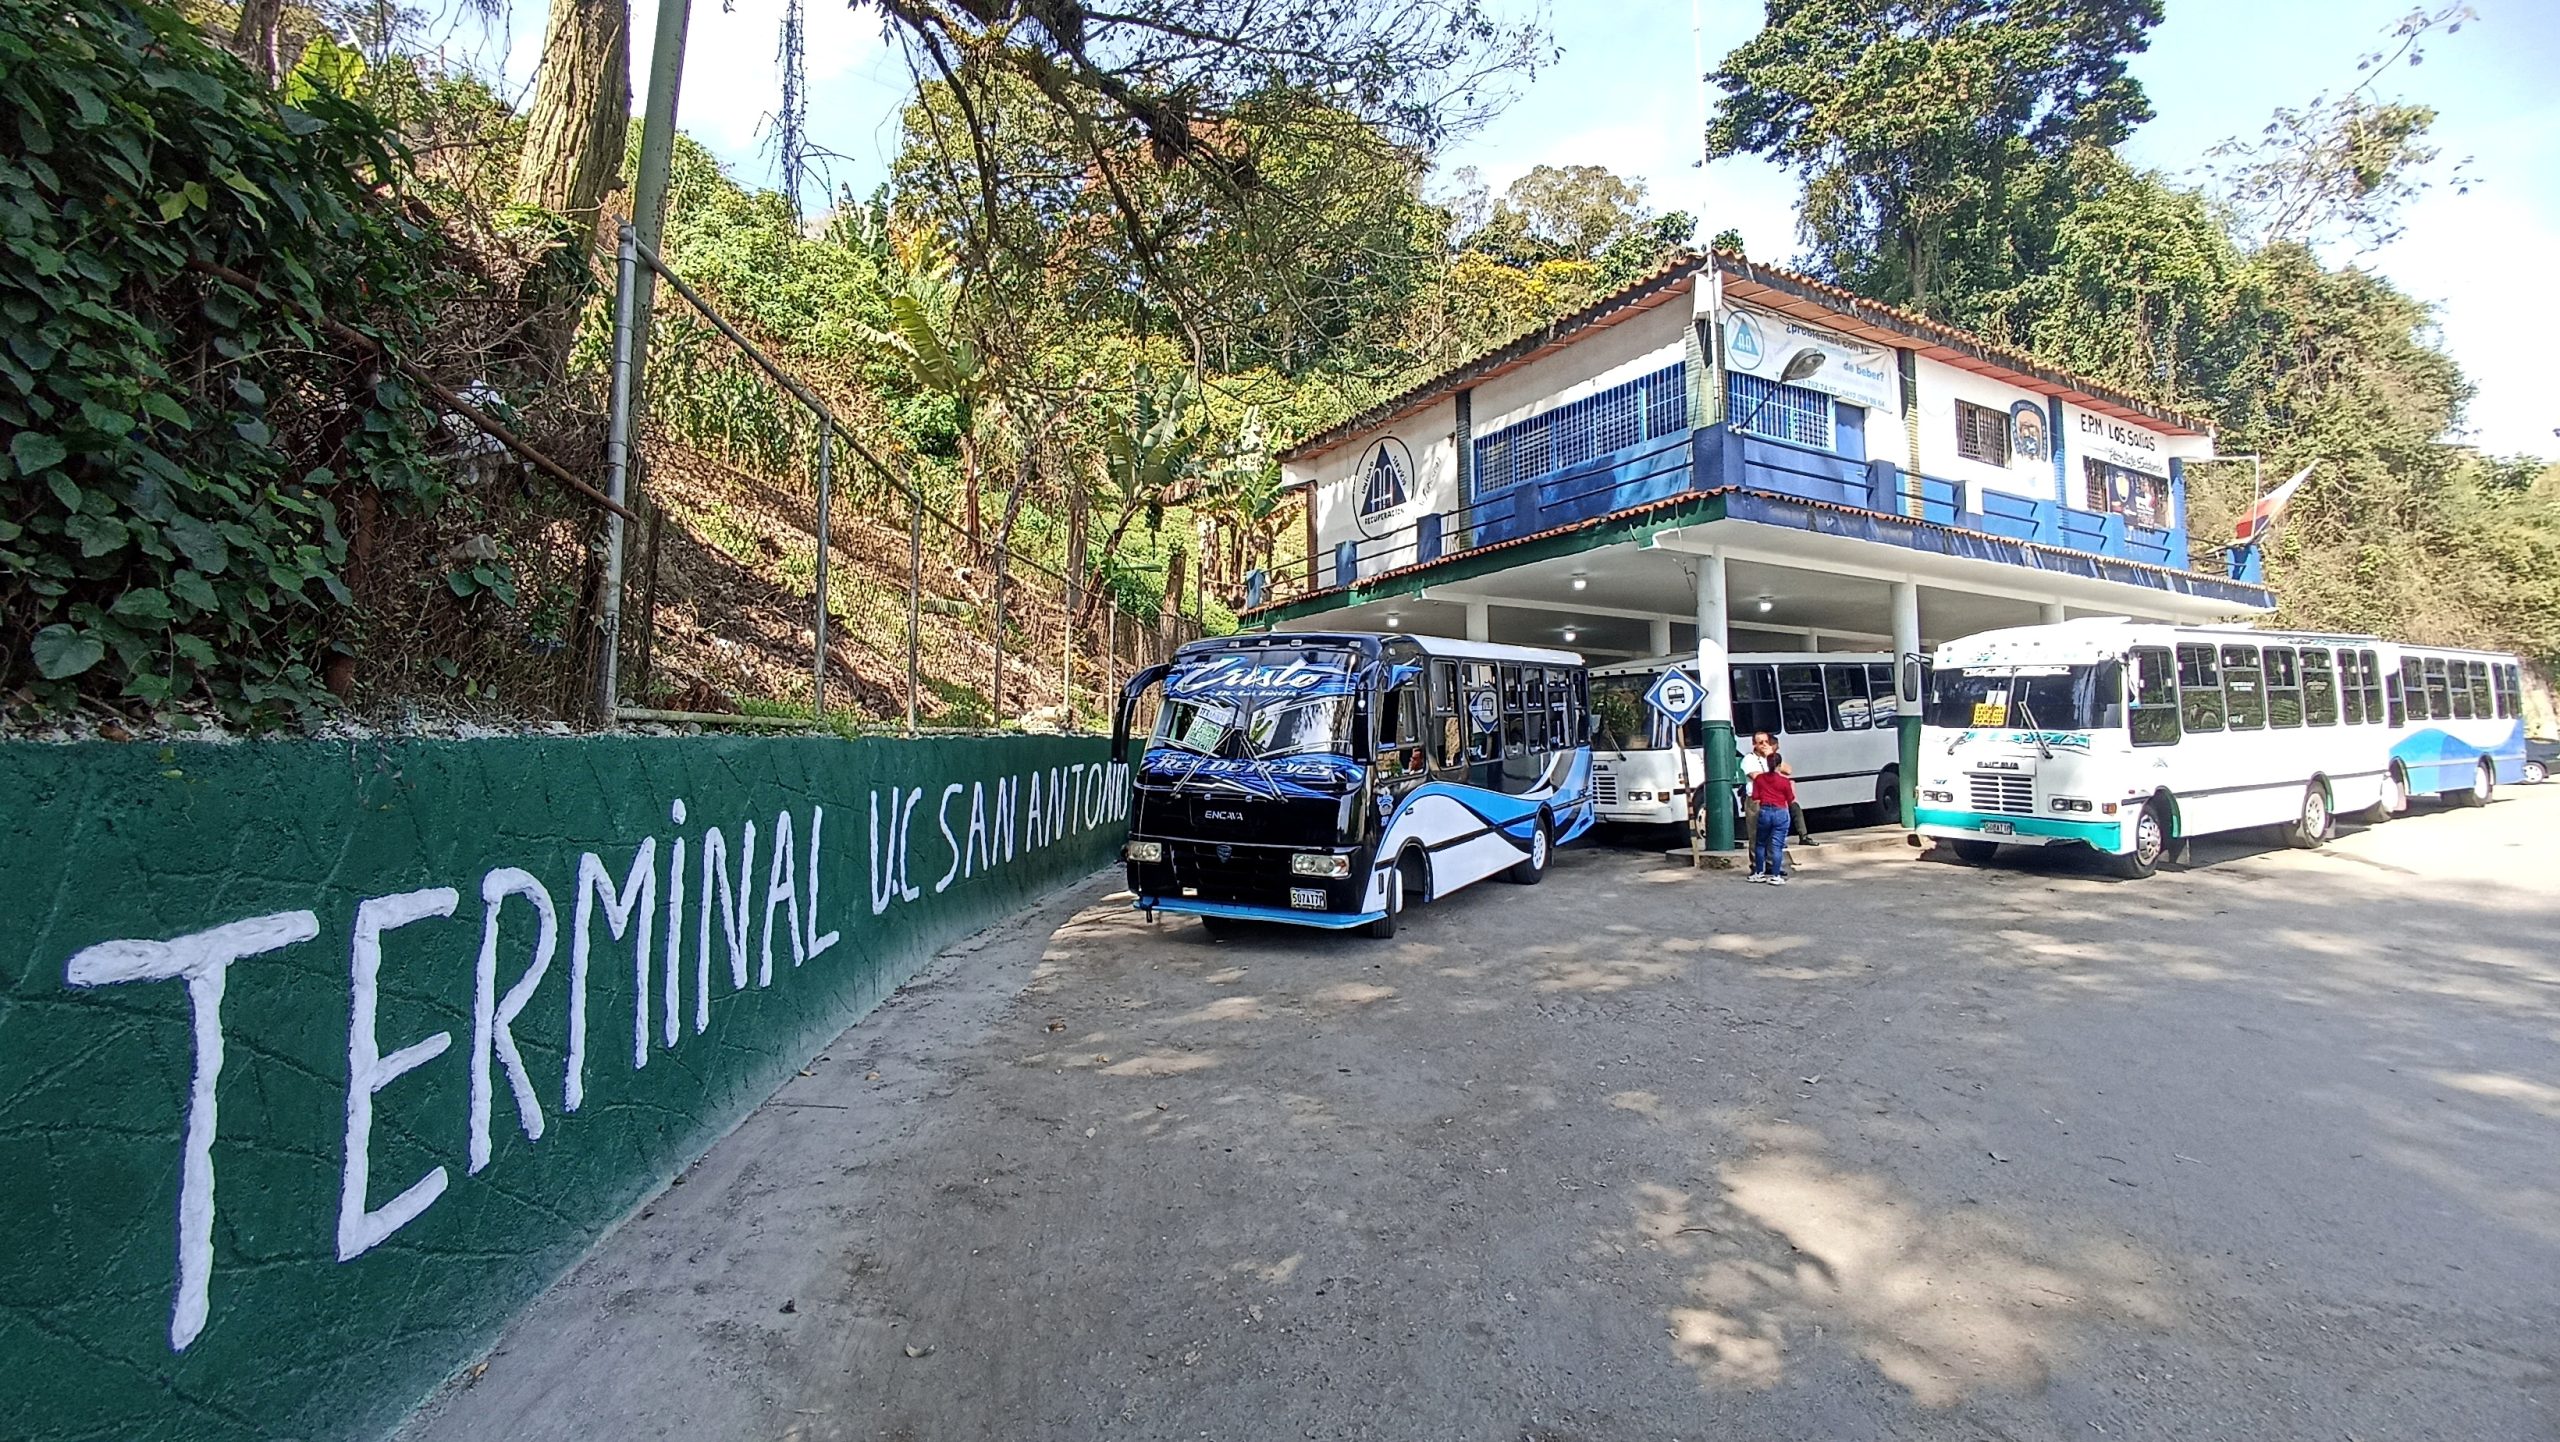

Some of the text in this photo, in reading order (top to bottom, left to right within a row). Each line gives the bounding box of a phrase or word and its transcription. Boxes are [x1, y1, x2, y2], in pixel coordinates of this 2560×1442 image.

[1857, 364, 1885, 382] beber?
[1204, 810, 1243, 821] ENCAVA
[936, 775, 1018, 894] SAN
[1026, 757, 1130, 852] ANTONIO
